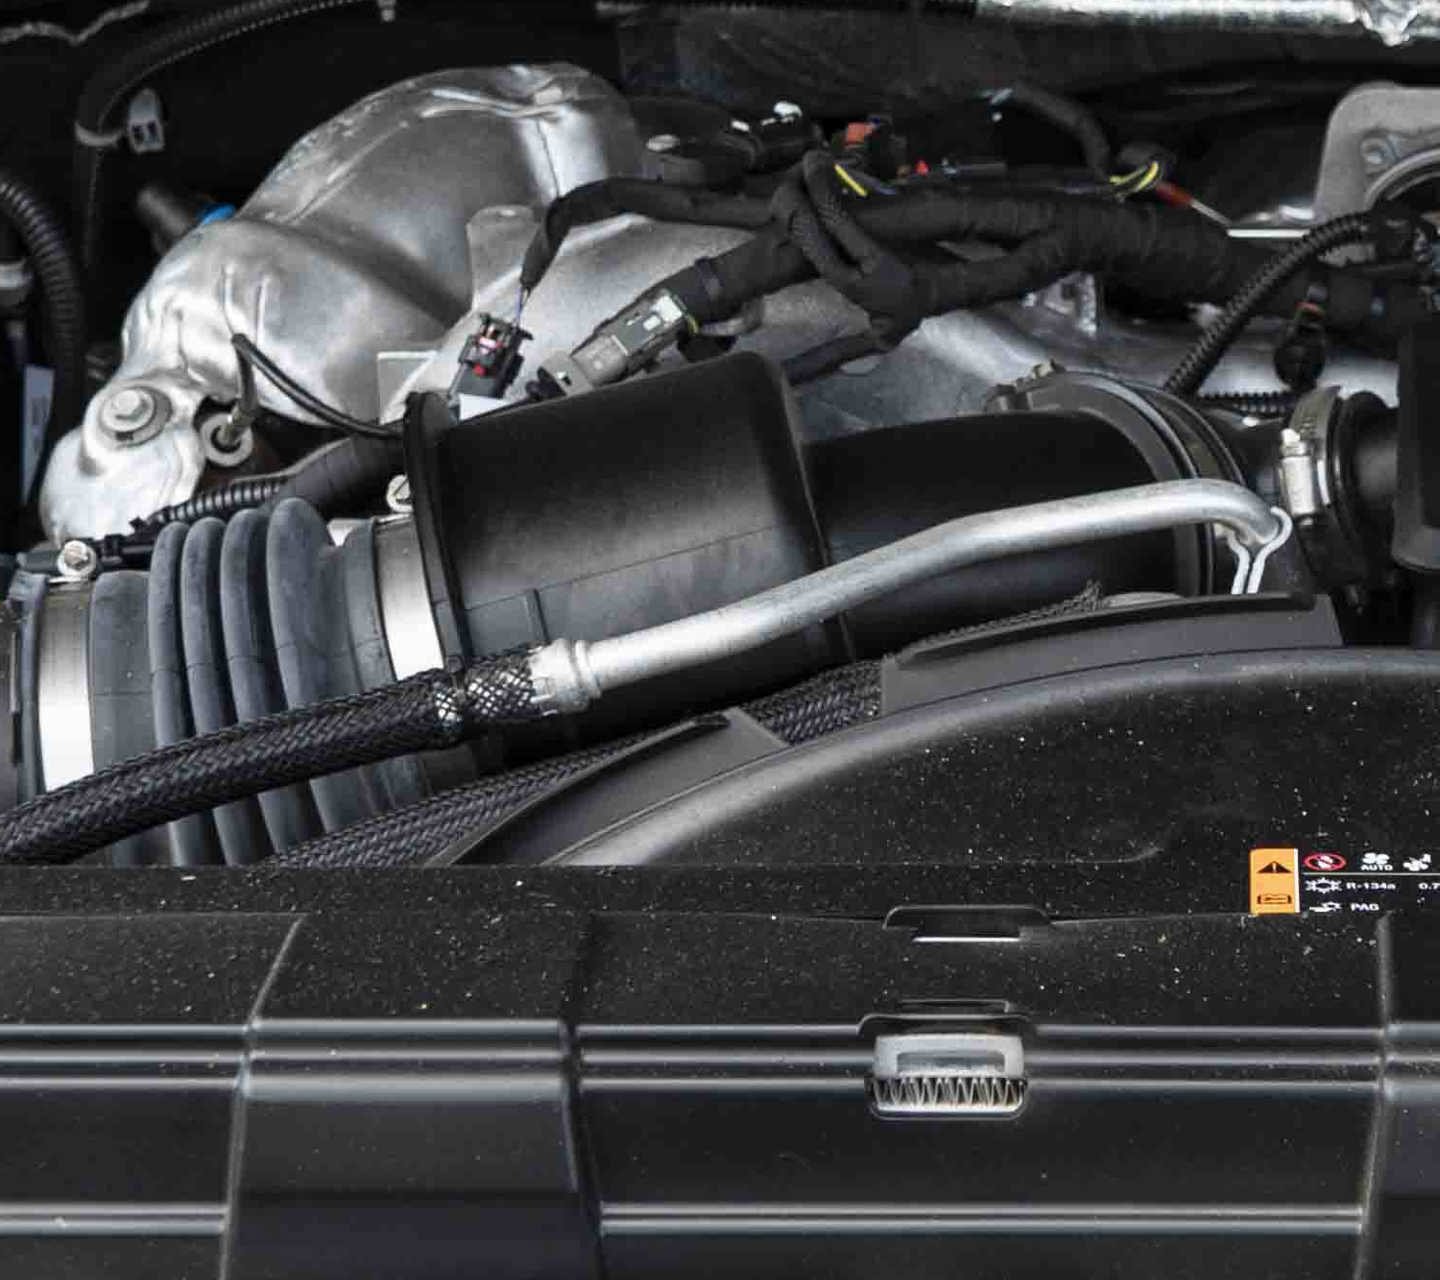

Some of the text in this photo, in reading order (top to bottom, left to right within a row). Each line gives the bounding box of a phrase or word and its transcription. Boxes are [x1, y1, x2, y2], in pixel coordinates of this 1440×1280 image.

[1360, 864, 1393, 872] AUTO
[1346, 882, 1396, 890] R-134a
[1350, 903, 1379, 911] PAG
